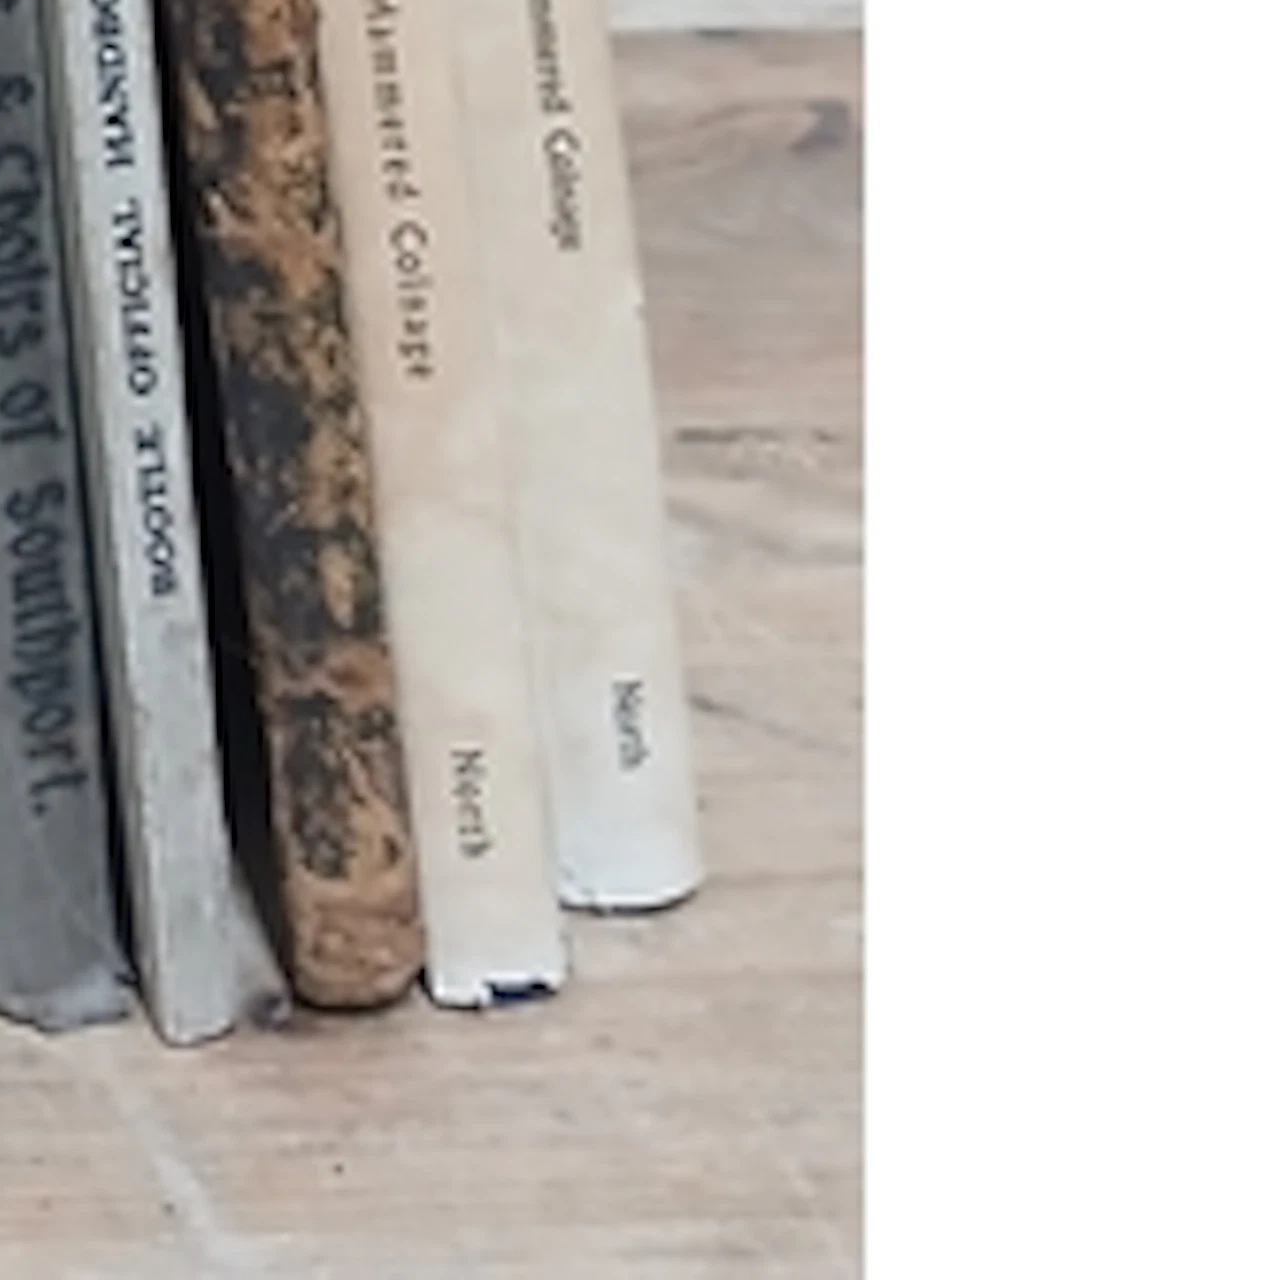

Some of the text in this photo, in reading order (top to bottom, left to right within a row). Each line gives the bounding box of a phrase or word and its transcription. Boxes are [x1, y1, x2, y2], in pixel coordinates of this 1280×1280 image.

[542, 126, 583, 253] Coinage
[111, 195, 160, 397] OFFICIAL
[390, 220, 435, 380] Coinage
[135, 420, 178, 597] BOOTLE
[611, 678, 651, 775] North
[449, 747, 495, 860] North
